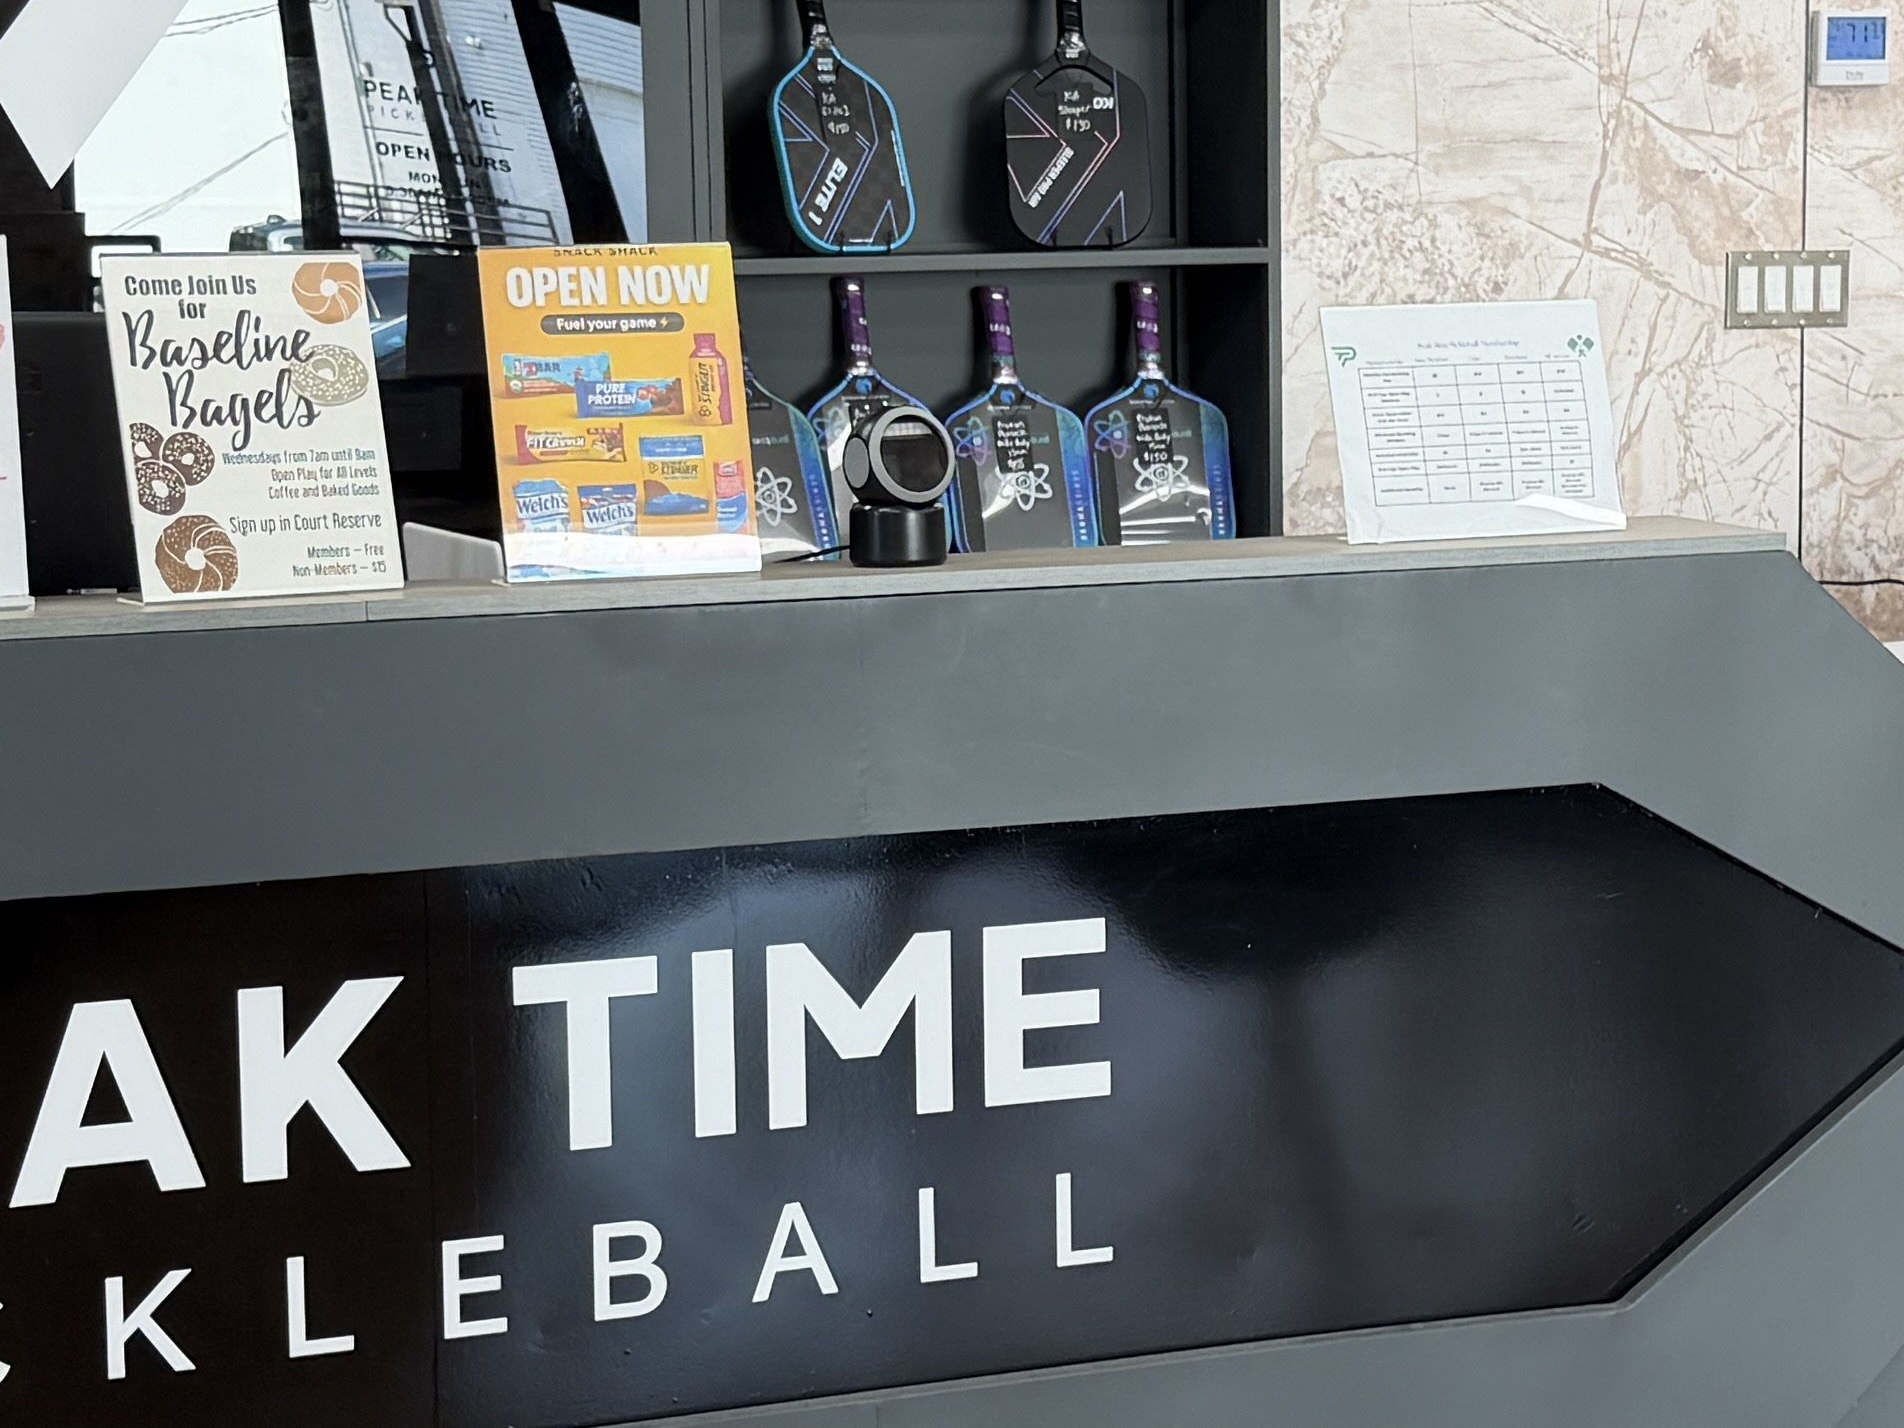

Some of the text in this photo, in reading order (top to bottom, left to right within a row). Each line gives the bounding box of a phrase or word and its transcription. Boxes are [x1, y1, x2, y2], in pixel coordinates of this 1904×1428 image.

[376, 141, 430, 162] OPEN
[814, 157, 849, 213] ELITE
[123, 273, 257, 297] Come Join Us
[506, 264, 710, 308] OPEN NOW
[178, 298, 207, 321] for
[556, 317, 657, 333] Fuel your game
[121, 308, 315, 372] Baseline
[595, 383, 626, 394] PURE
[162, 367, 322, 452] Bagels
[587, 393, 637, 406] PROTEIN
[221, 448, 353, 466] Wednesdays from 7am until
[296, 467, 318, 482] Play
[319, 466, 334, 480] for
[302, 485, 320, 498] and
[321, 483, 350, 498] Baked
[516, 493, 569, 514] Welch's
[585, 503, 636, 524] Welch's
[229, 512, 383, 537] Sign up in Court Reserve
[307, 543, 385, 559] Members Free
[371, 560, 387, 573] $15
[511, 915, 1112, 1152] TIME
